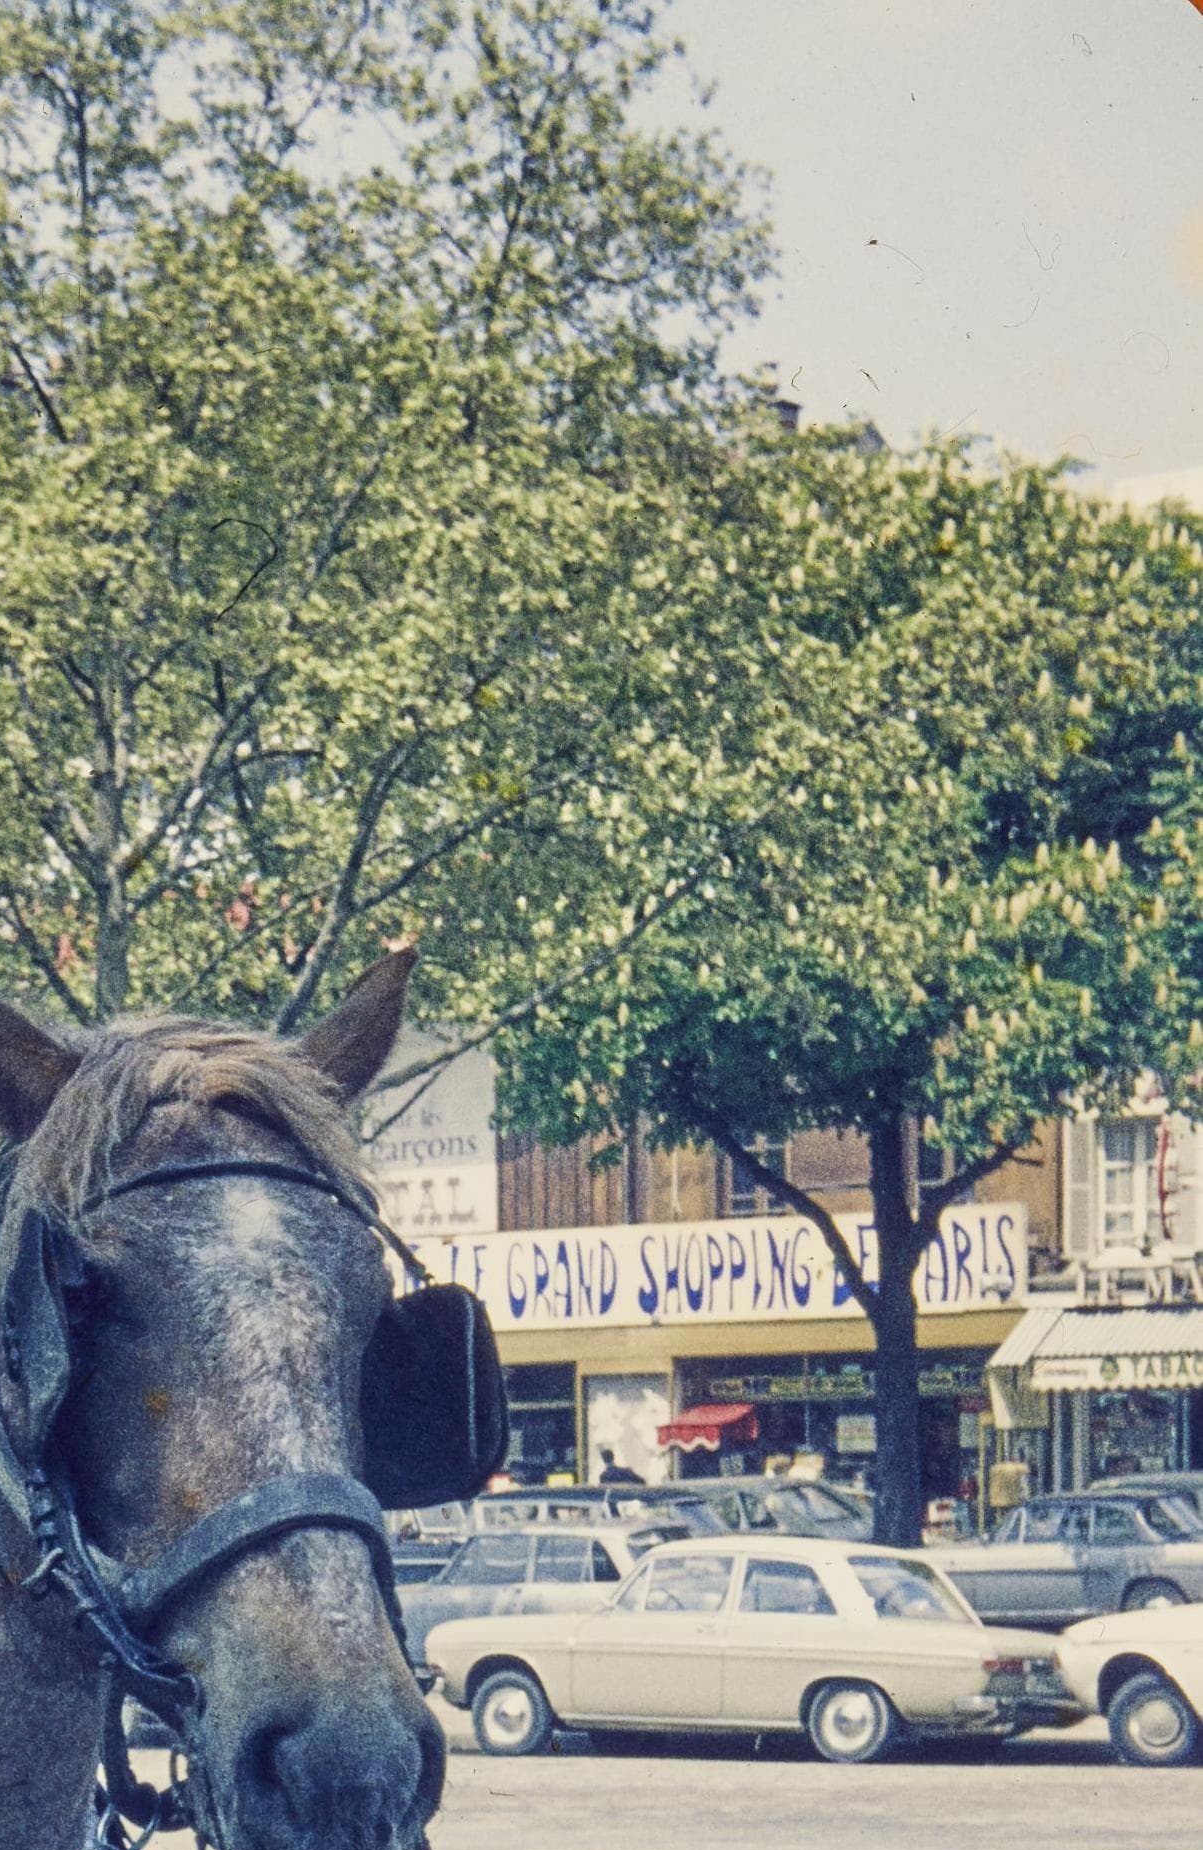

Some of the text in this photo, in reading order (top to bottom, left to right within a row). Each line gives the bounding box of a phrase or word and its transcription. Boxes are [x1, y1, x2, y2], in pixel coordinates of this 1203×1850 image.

[507, 1239, 618, 1320] GRAND
[638, 1226, 812, 1316] SHOPPING
[922, 1214, 1016, 1305] ARIS
